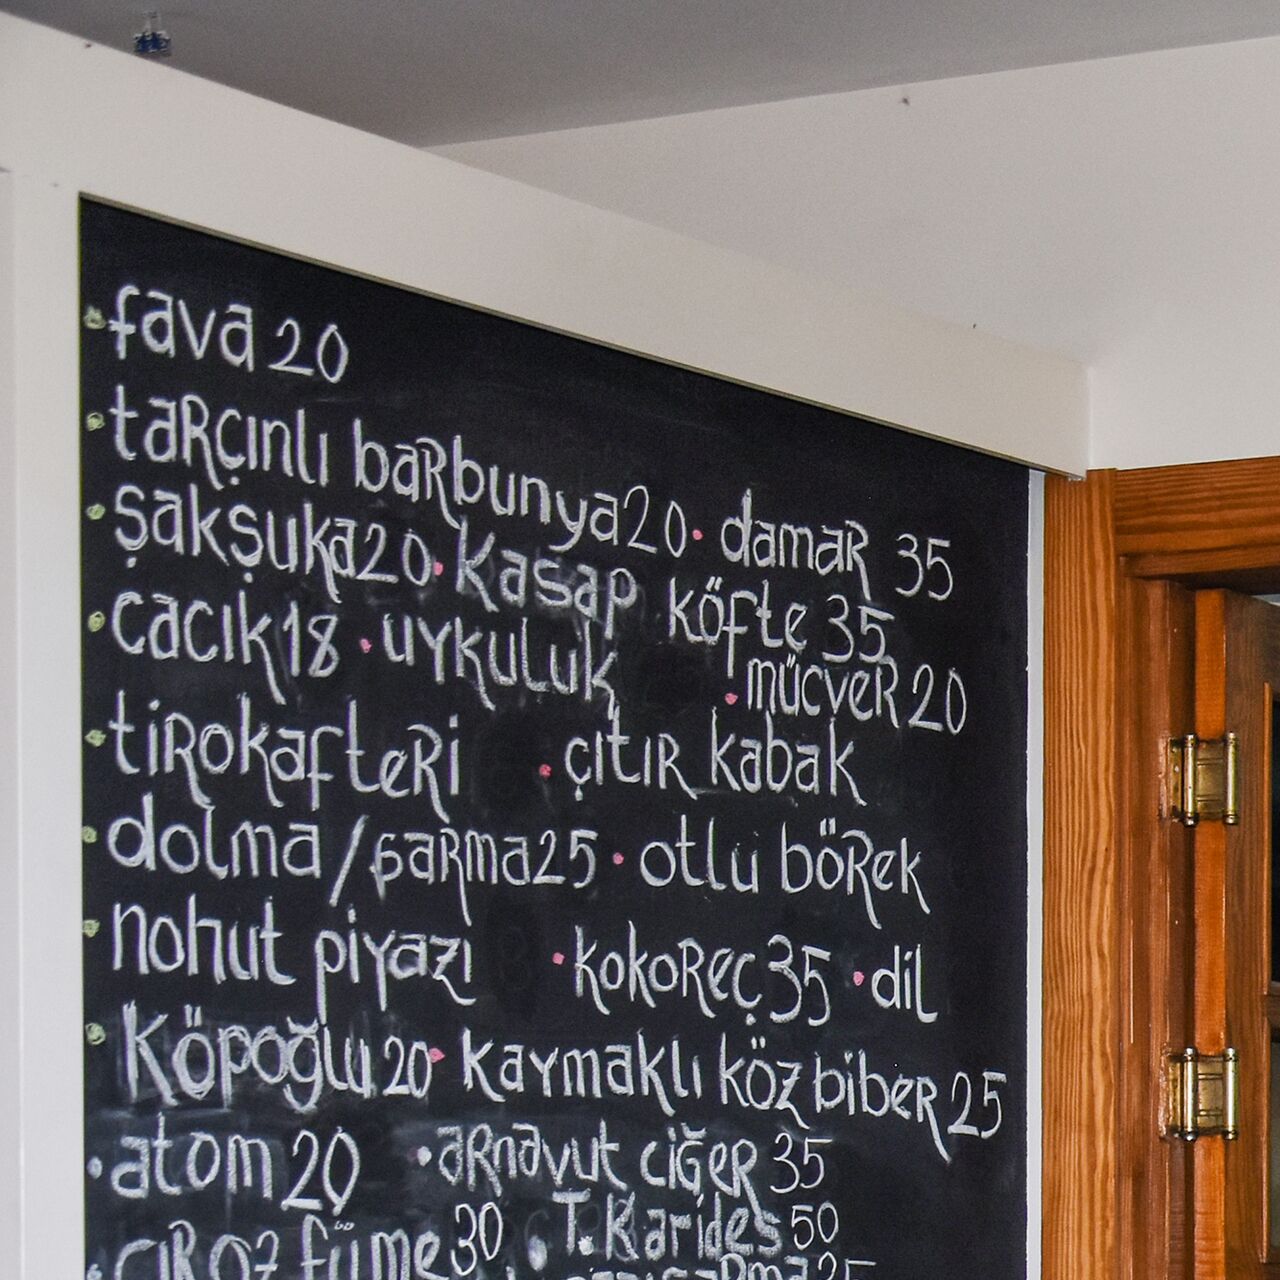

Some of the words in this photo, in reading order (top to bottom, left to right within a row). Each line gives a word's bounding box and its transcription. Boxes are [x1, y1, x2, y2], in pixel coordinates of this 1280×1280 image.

[109, 285, 253, 372] fava
[268, 319, 349, 384] 20
[896, 533, 955, 600] 35
[670, 576, 809, 679] köfte
[822, 594, 896, 664] 35
[906, 663, 968, 735] 20
[710, 707, 867, 806] kabak
[112, 893, 297, 986] nohut
[870, 943, 939, 1024] dil
[110, 1111, 275, 1202] atom
[280, 1126, 361, 1217] 20
[769, 1132, 834, 1194] 35
[790, 1202, 840, 1251] 50
